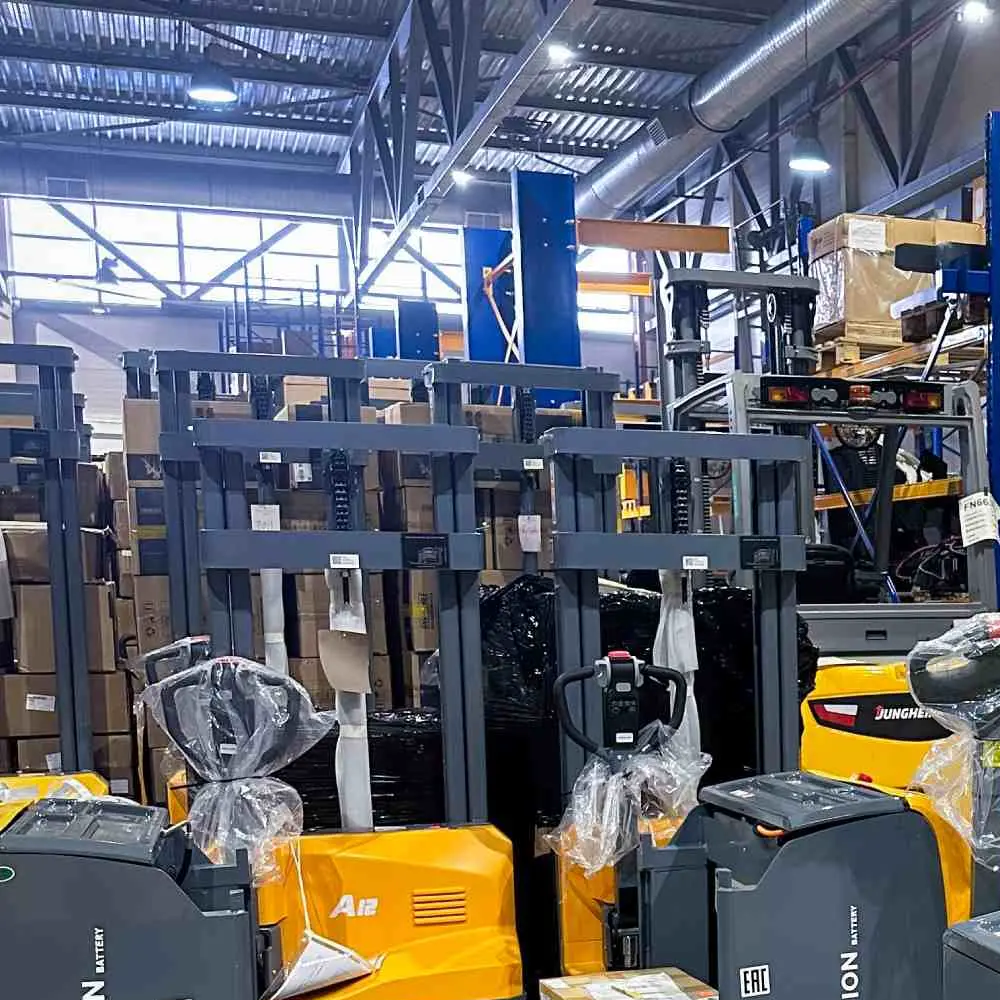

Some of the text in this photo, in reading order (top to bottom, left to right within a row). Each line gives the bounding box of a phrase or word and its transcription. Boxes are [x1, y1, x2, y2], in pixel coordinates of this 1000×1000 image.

[850, 905, 858, 945] BATTERY
[94, 927, 105, 973] BATTERY
[743, 968, 768, 994] EAC
